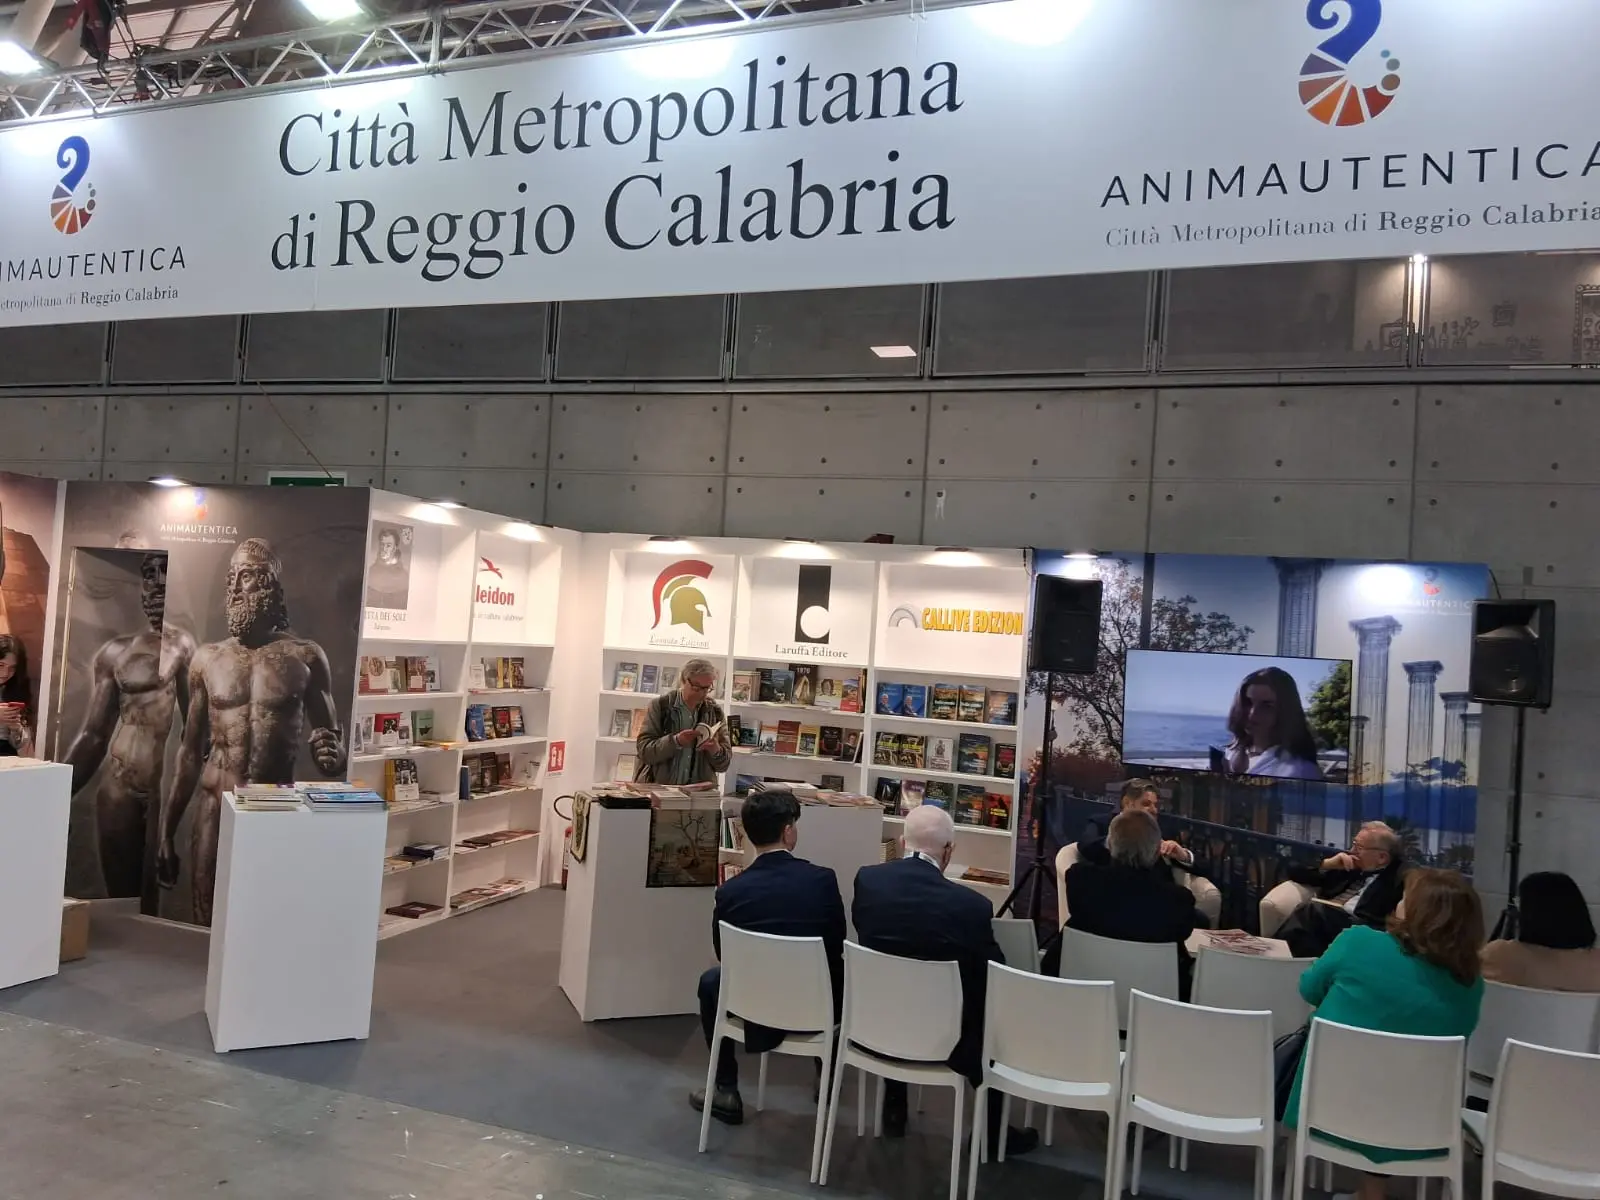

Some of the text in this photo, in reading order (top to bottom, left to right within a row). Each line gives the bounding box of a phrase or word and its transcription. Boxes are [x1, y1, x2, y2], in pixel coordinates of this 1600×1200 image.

[279, 55, 964, 176] Città Metropolitana
[1100, 141, 1600, 208] ANIMAUTENTICA
[271, 150, 955, 282] di Reggio Calabria
[1105, 226, 1161, 247] Città
[1171, 218, 1334, 245] Metropolitana
[1344, 213, 1367, 232] di
[1377, 208, 1471, 235] Reggio
[65, 292, 76, 305] di
[80, 289, 121, 307] Reggio
[125, 285, 179, 302] Calabria
[160, 523, 238, 535] ANIMAUTENTICA
[922, 607, 970, 632] CALLIVE
[775, 643, 849, 659] Laruffa Editore
